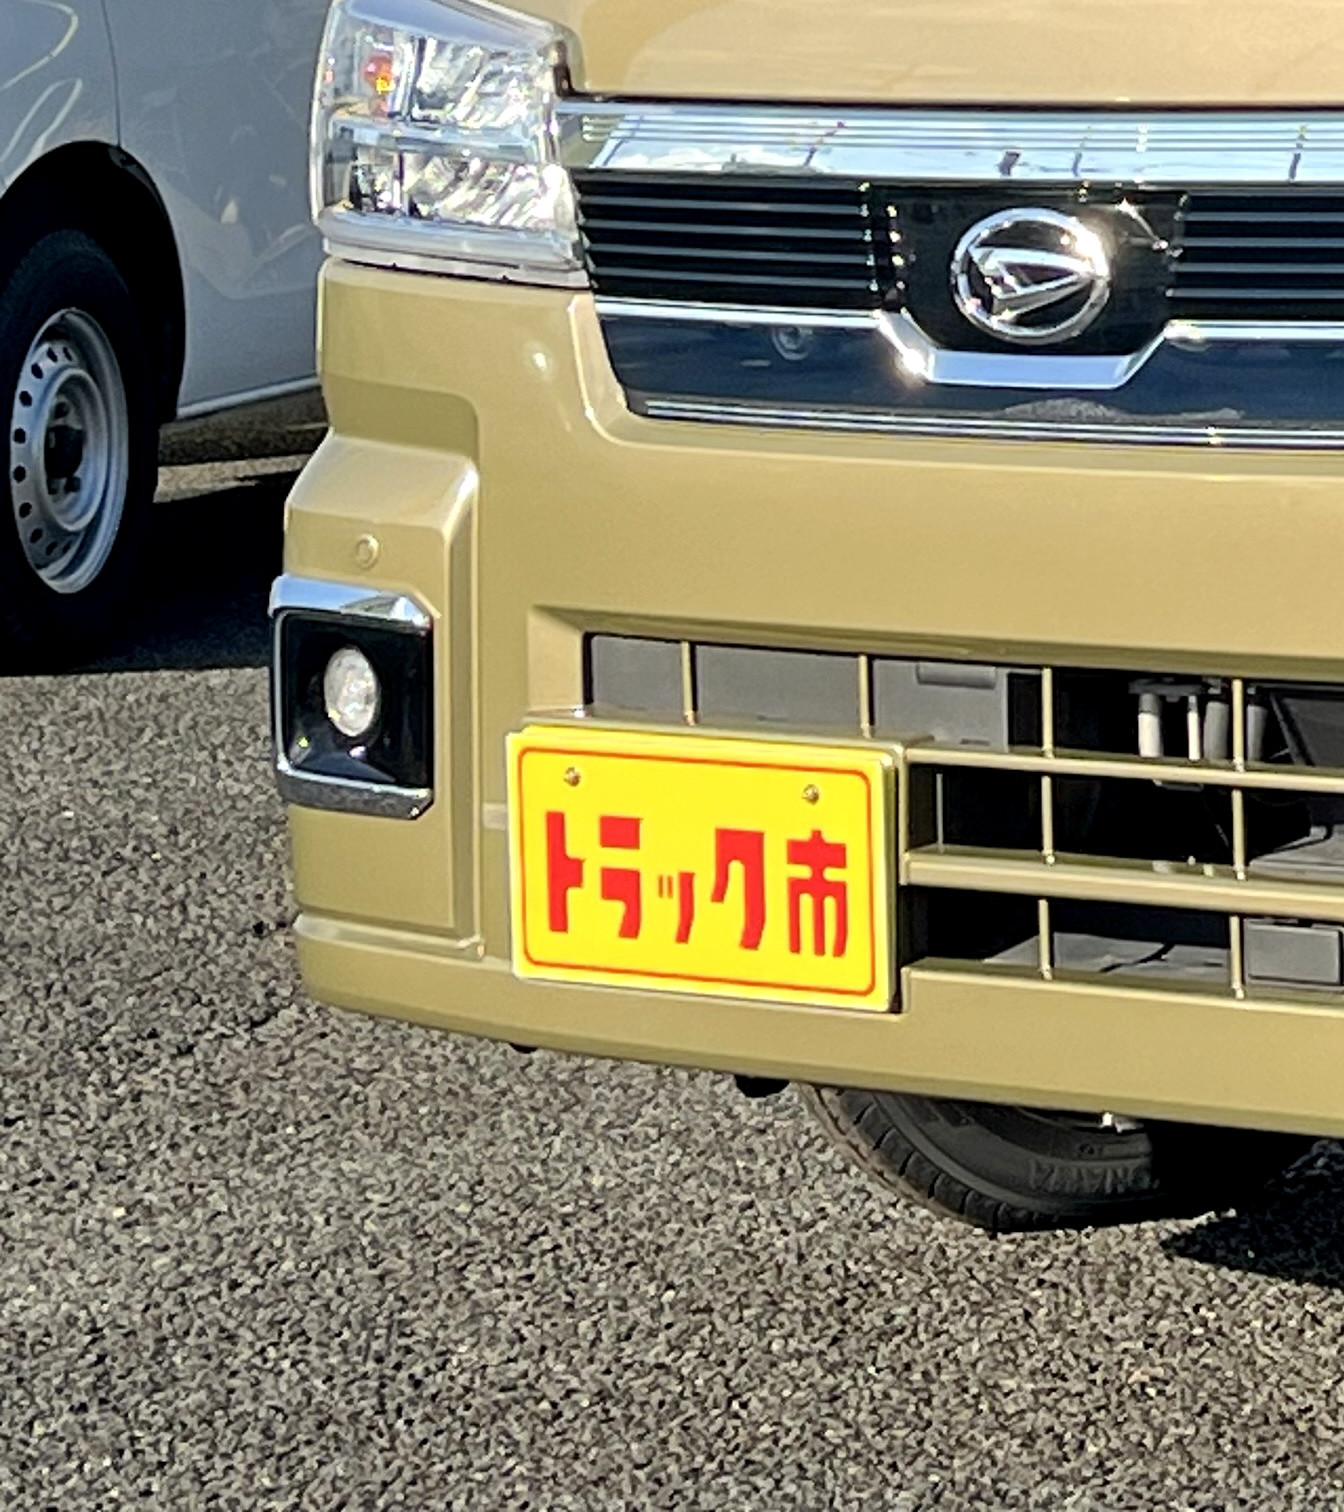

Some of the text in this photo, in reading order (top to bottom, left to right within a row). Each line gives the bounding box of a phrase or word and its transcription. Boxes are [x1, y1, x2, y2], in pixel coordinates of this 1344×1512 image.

[545, 810, 849, 958] トラック市
